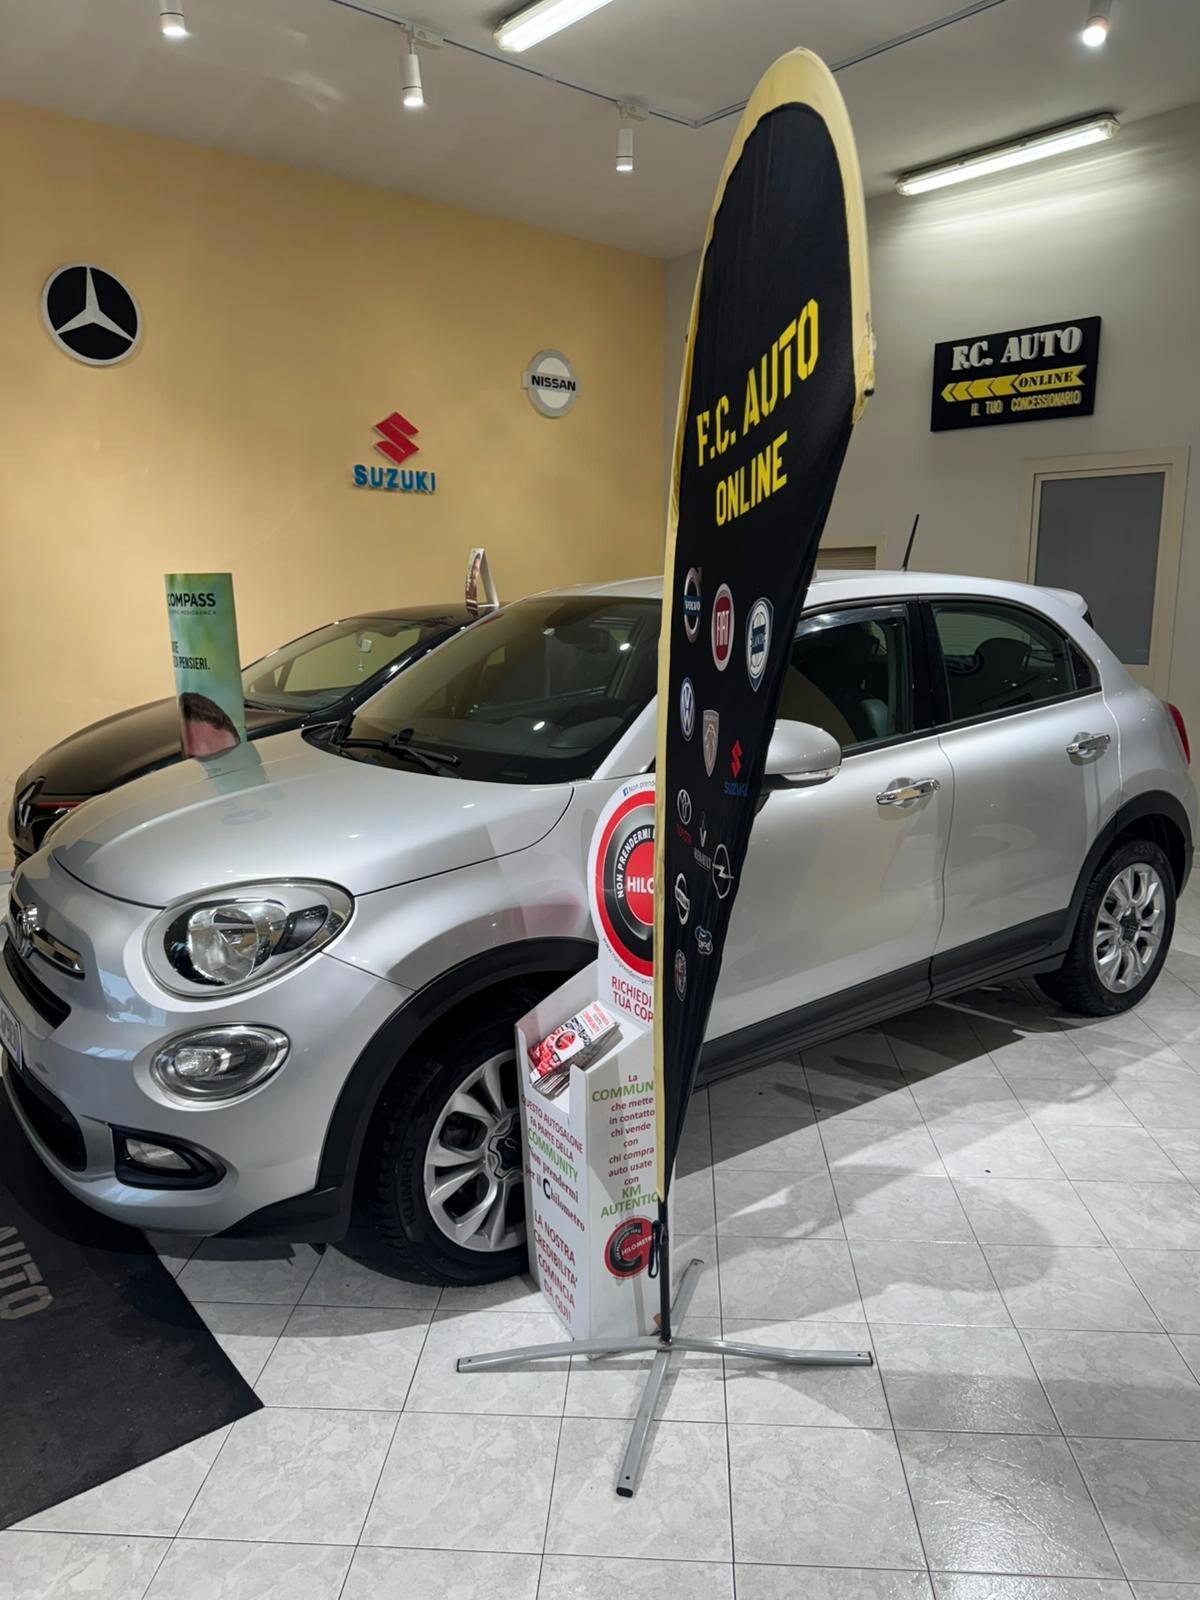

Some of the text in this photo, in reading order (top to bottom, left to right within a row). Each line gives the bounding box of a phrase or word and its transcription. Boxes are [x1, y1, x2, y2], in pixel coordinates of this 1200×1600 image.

[951, 326, 1084, 371] F.C. AUTO
[531, 374, 576, 391] NISSAN
[696, 298, 819, 467] F.C. AUTO
[1019, 371, 1073, 388] ONLINE
[970, 390, 1082, 416] IL TUO CONCESSIONARIO
[353, 464, 436, 492] SUZUKI
[716, 430, 788, 527] ONLINE
[684, 600, 701, 611] VOLVO
[716, 610, 730, 646] FIAT
[723, 781, 748, 797] SUZUKI
[616, 828, 651, 898] NON PRENDERMI
[611, 976, 652, 1008] RICHIEDI
[613, 991, 632, 1012] TUA
[628, 1075, 638, 1083] La
[592, 1080, 655, 1102] COMMUN
[611, 1097, 654, 1111] che mette
[609, 1109, 655, 1125] in contatto
[543, 1113, 583, 1153] AUTOSALONE
[611, 1122, 651, 1138] chi vende
[537, 1122, 554, 1145] PARTE
[555, 1139, 574, 1162] DELLA
[624, 1139, 638, 1148] con
[528, 1127, 578, 1182] COMMUNITY
[609, 1147, 655, 1164] chi compra
[608, 1160, 653, 1177] auto usate
[542, 1162, 579, 1203] prendermi
[622, 1184, 641, 1199] KM
[624, 1176, 639, 1185] con
[535, 1209, 575, 1266] LA NOSTRA
[538, 1253, 575, 1309] COMINCIA
